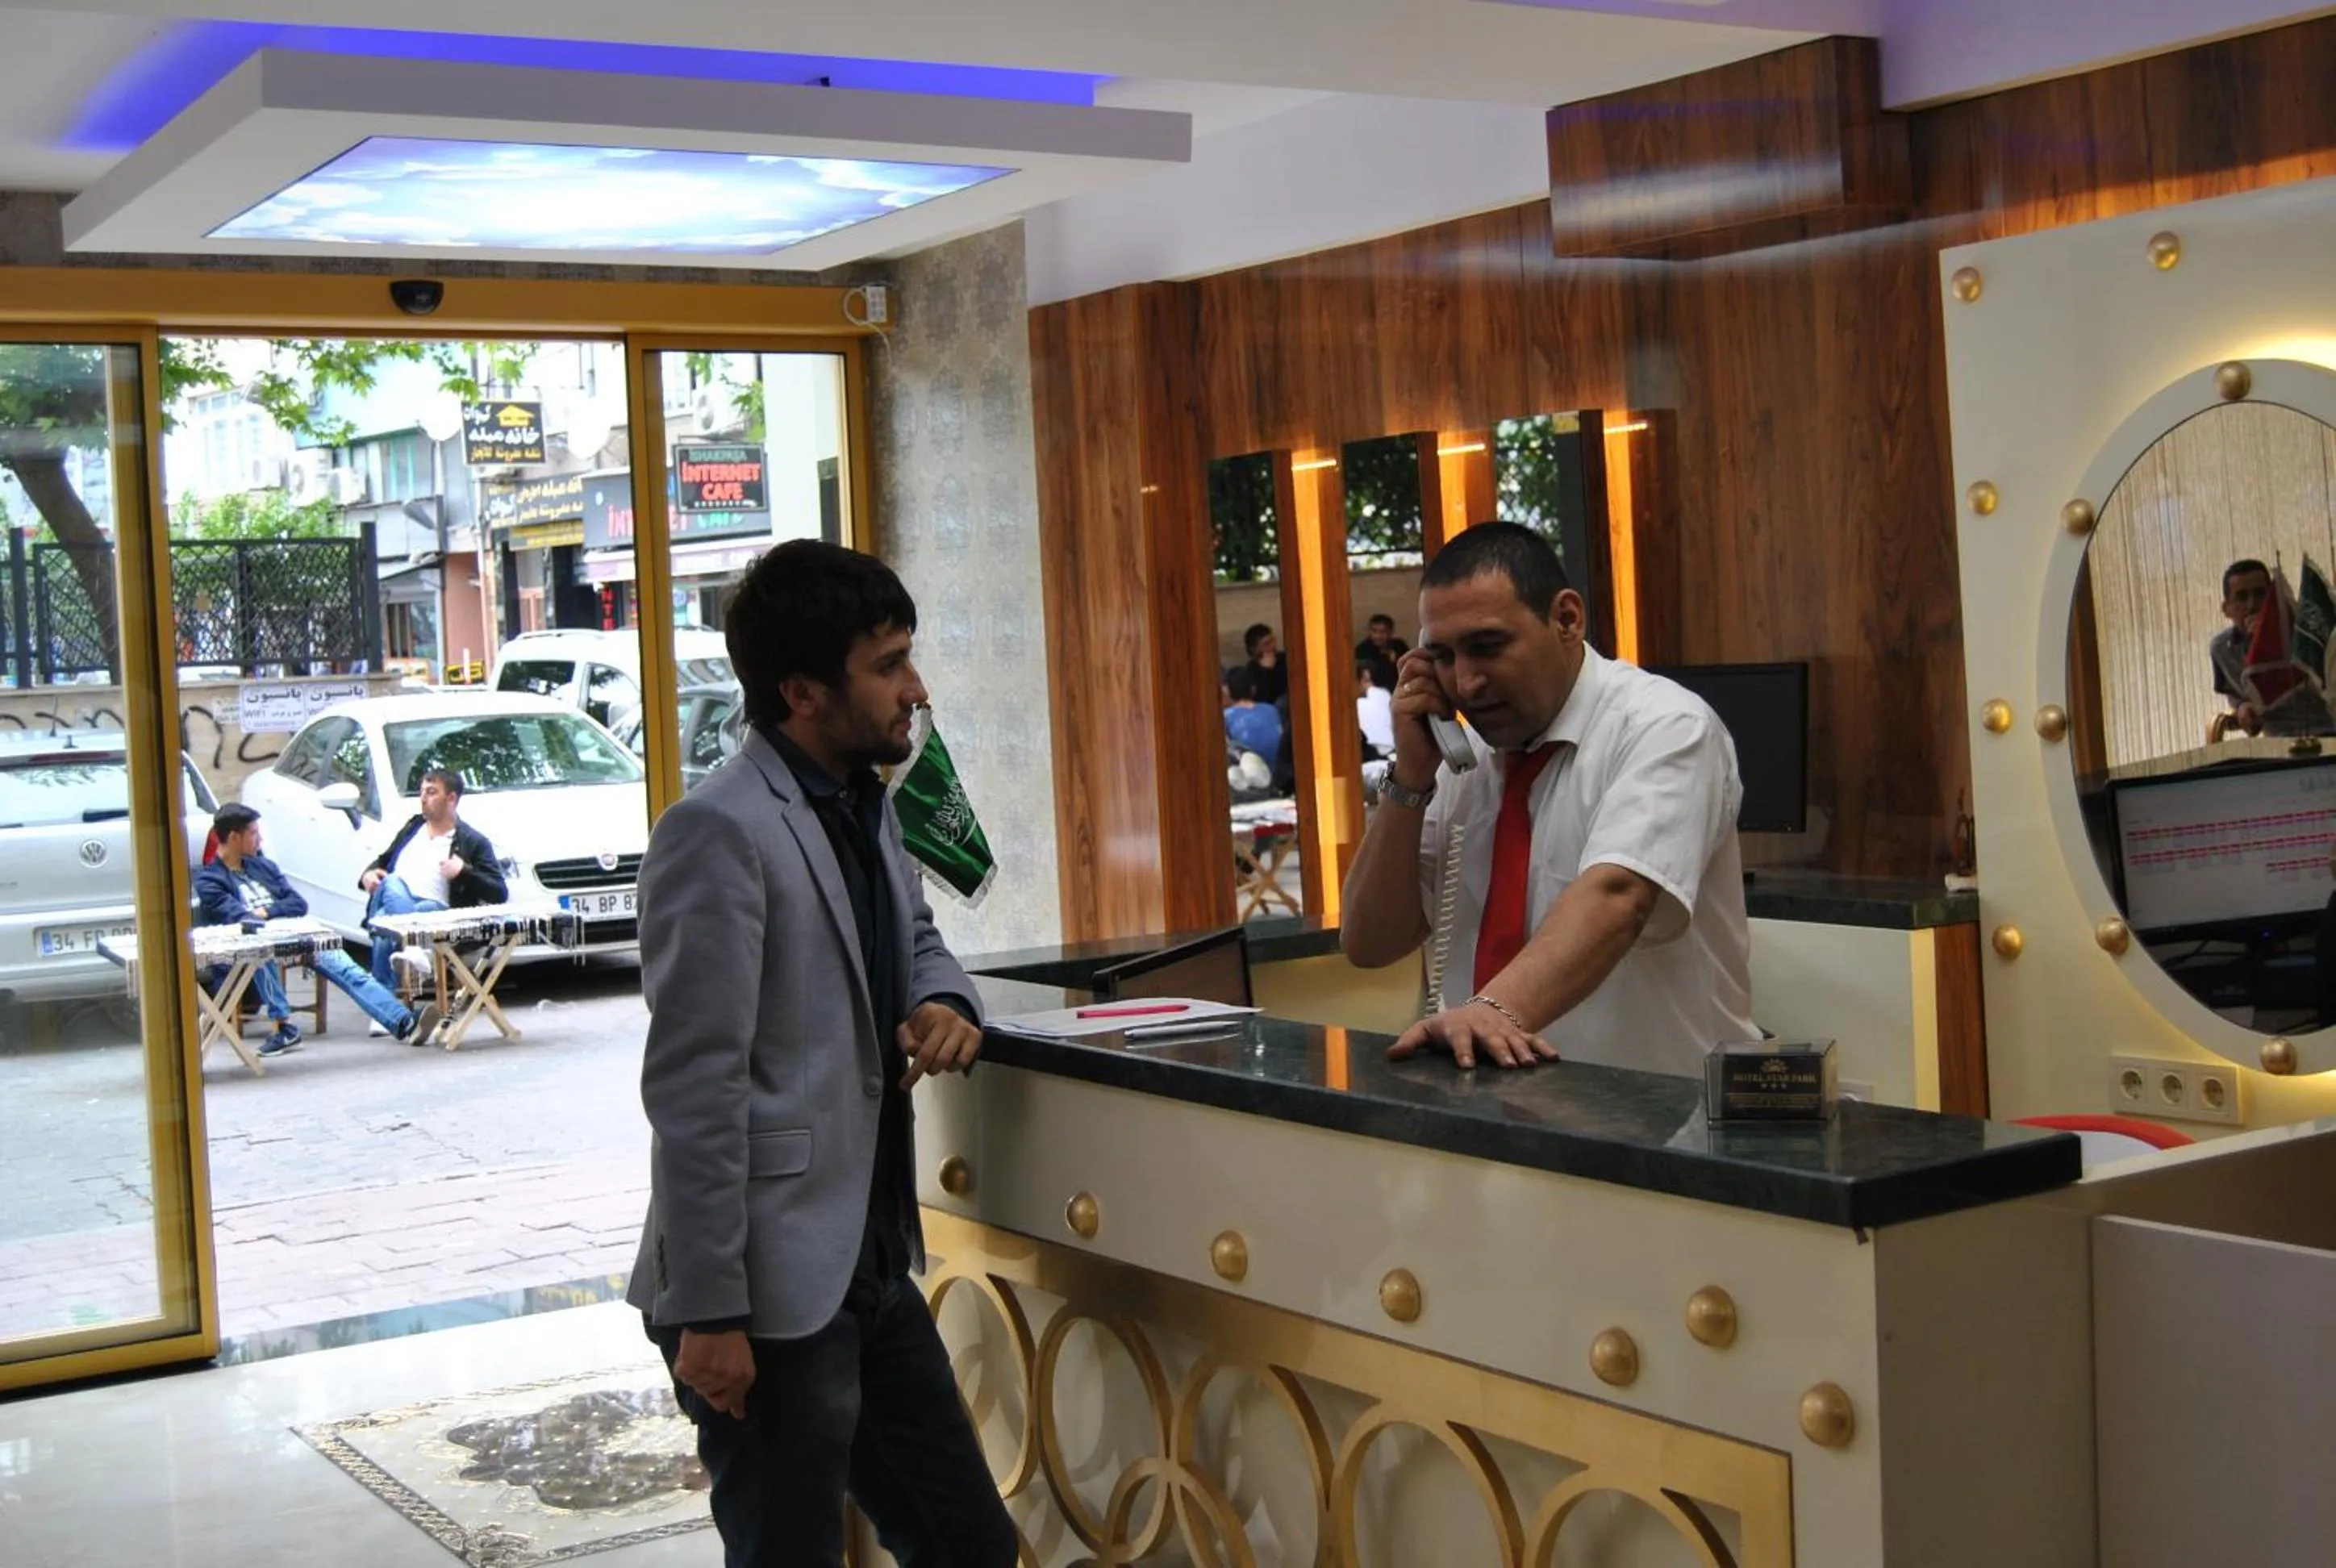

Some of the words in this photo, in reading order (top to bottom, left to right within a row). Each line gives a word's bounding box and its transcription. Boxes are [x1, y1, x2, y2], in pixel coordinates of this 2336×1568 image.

[702, 482, 743, 501] CAFE
[599, 895, 617, 913] BP
[53, 933, 74, 951] 34
